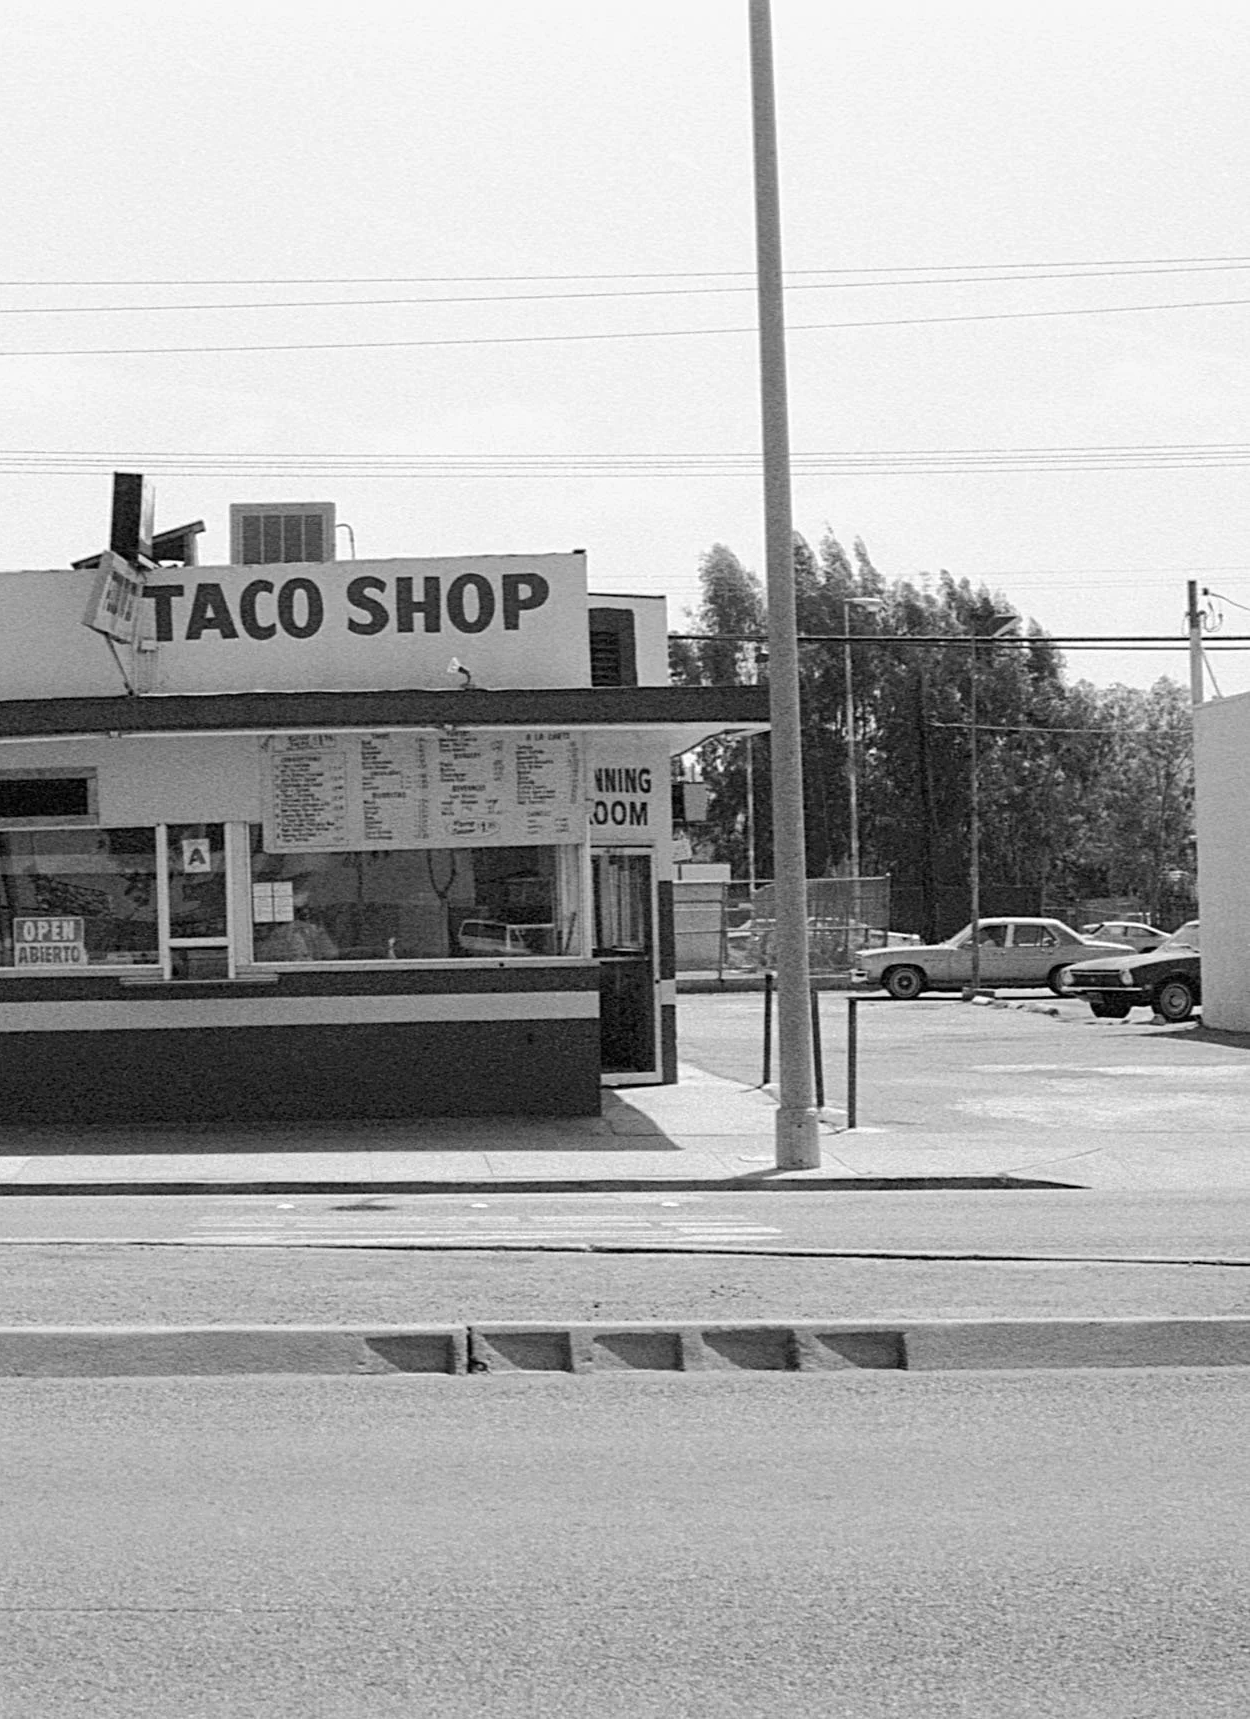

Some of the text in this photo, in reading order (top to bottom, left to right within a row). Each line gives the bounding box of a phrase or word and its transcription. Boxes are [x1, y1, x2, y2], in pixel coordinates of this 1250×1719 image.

[143, 577, 323, 642] TACO
[346, 572, 549, 635] SHOP
[589, 800, 648, 826] OOM
[188, 848, 206, 865] A
[23, 920, 75, 941] OPEN
[18, 945, 80, 964] ABIERTO
